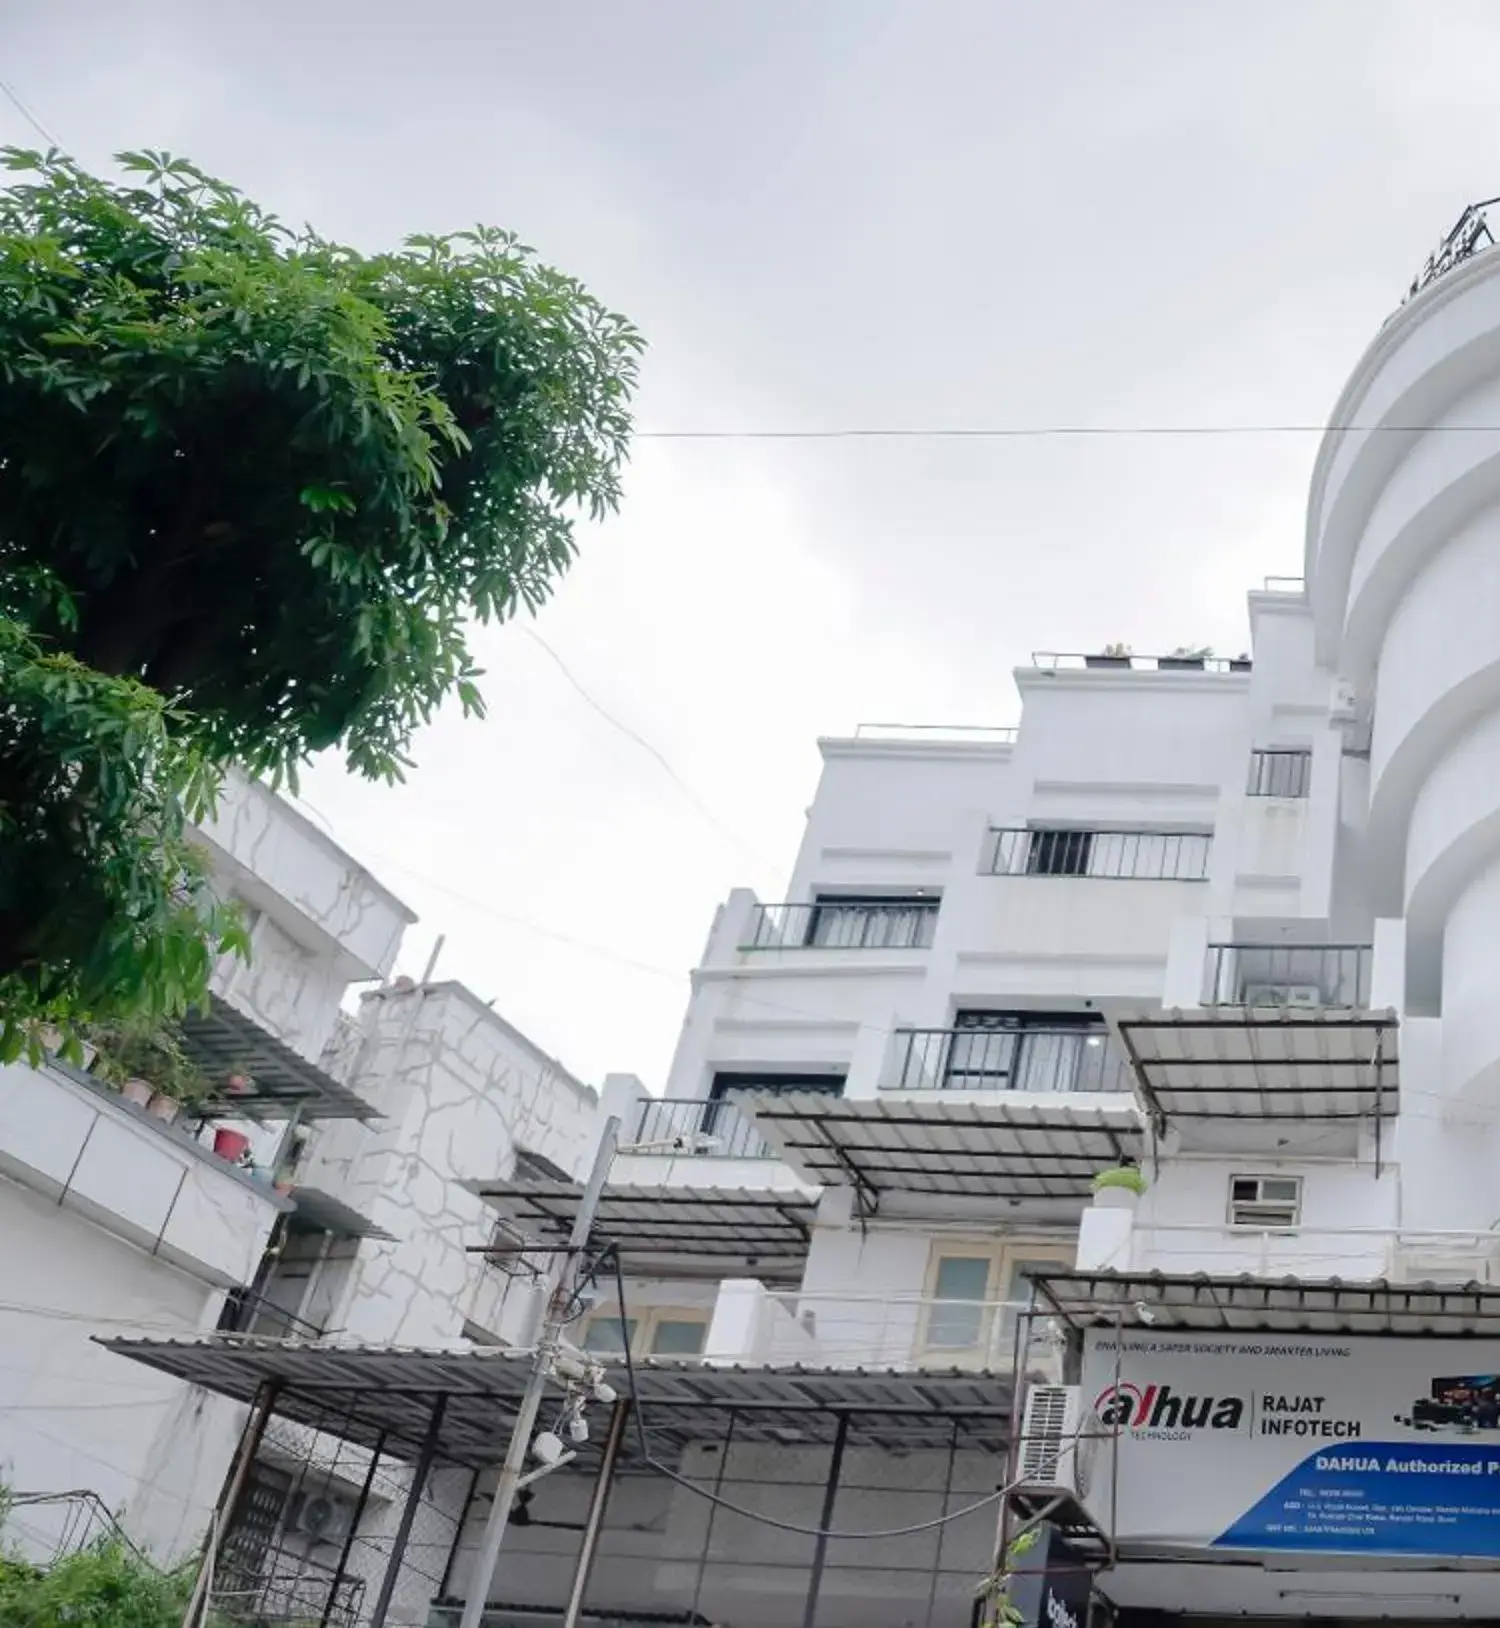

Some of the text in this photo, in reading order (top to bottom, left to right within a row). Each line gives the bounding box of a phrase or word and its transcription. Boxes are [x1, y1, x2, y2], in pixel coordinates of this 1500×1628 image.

[1262, 1395, 1327, 1413] RAJAT
[1261, 1419, 1361, 1438] INFOTECH
[1315, 1457, 1380, 1472] DAHUA
[1386, 1459, 1483, 1475] Authorized
